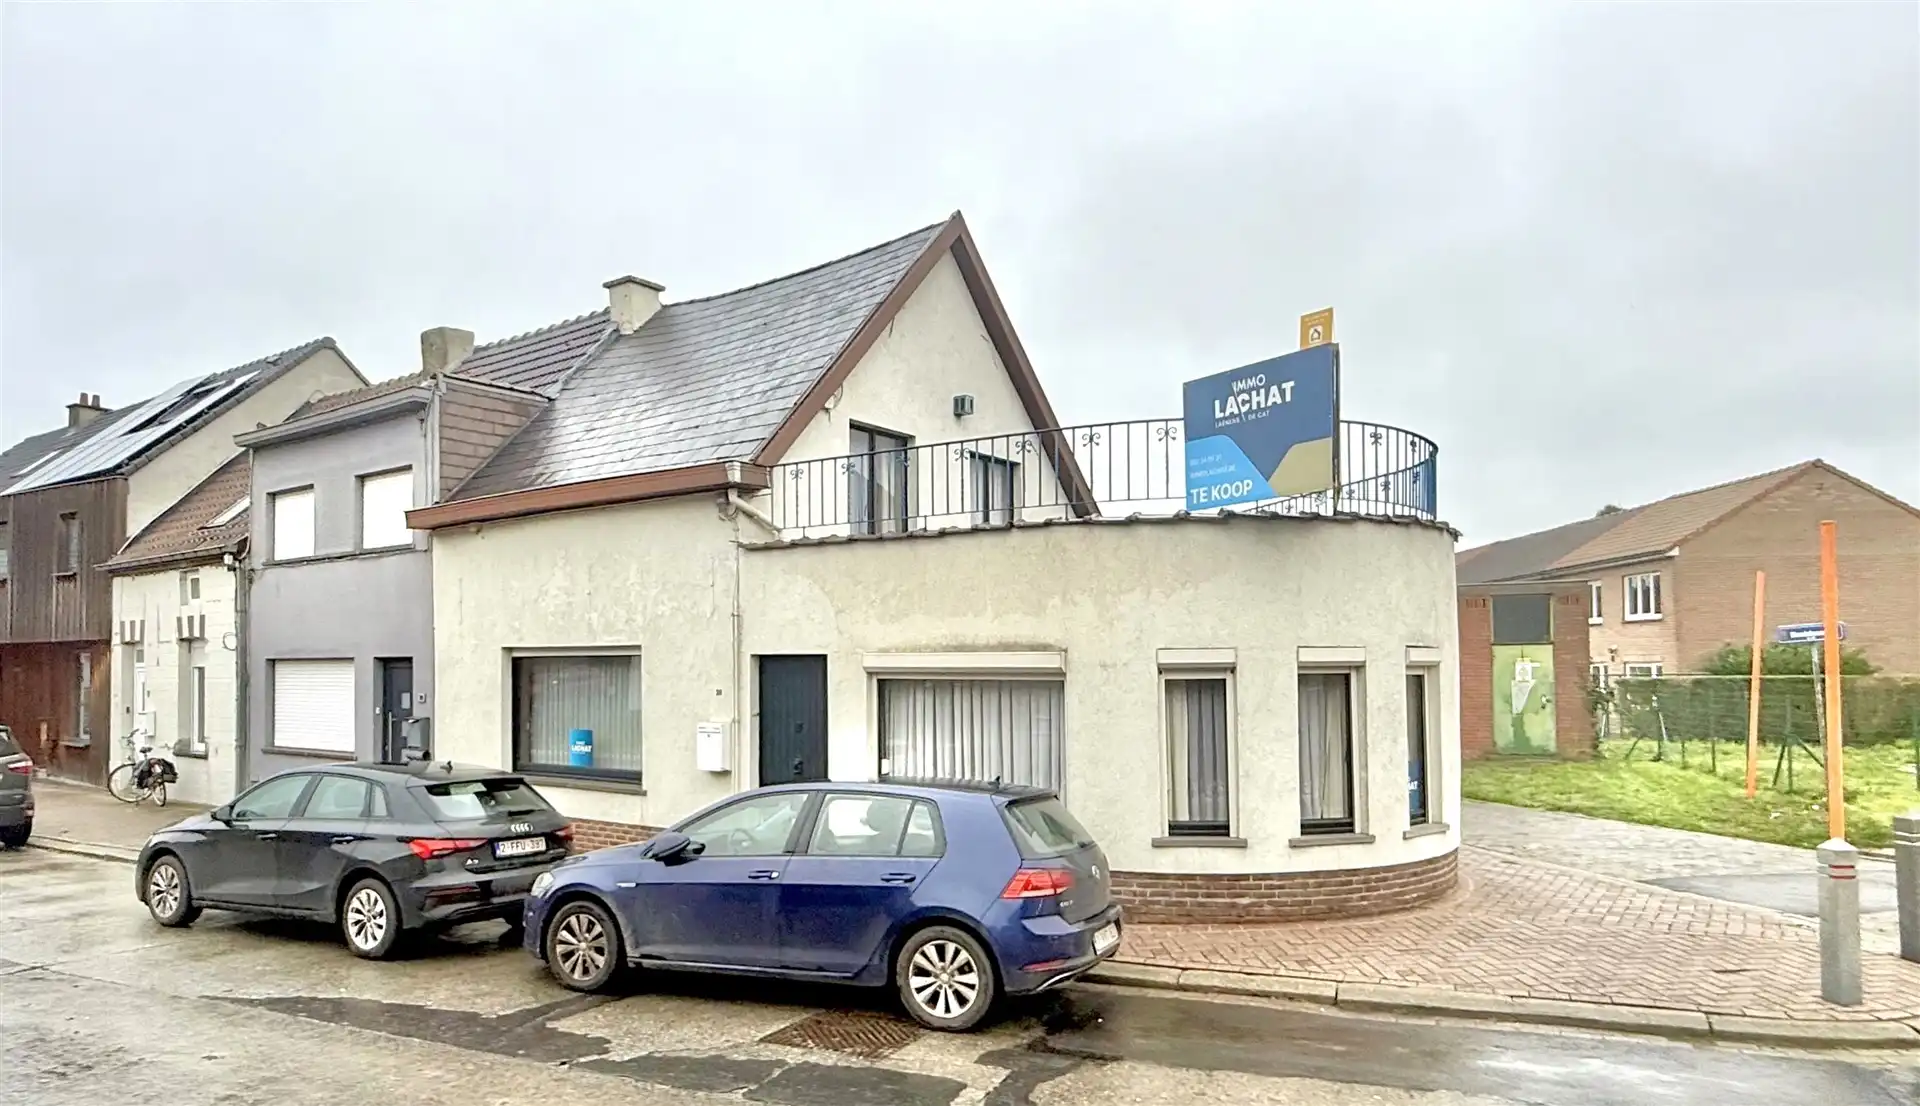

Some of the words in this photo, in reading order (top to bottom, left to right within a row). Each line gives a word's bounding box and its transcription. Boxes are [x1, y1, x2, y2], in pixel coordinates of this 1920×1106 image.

[1231, 374, 1266, 394] IMMO
[1214, 381, 1295, 419] LACHAT
[1257, 410, 1270, 418] CAT
[1190, 487, 1209, 504] TE
[1211, 480, 1253, 501] KOOP
